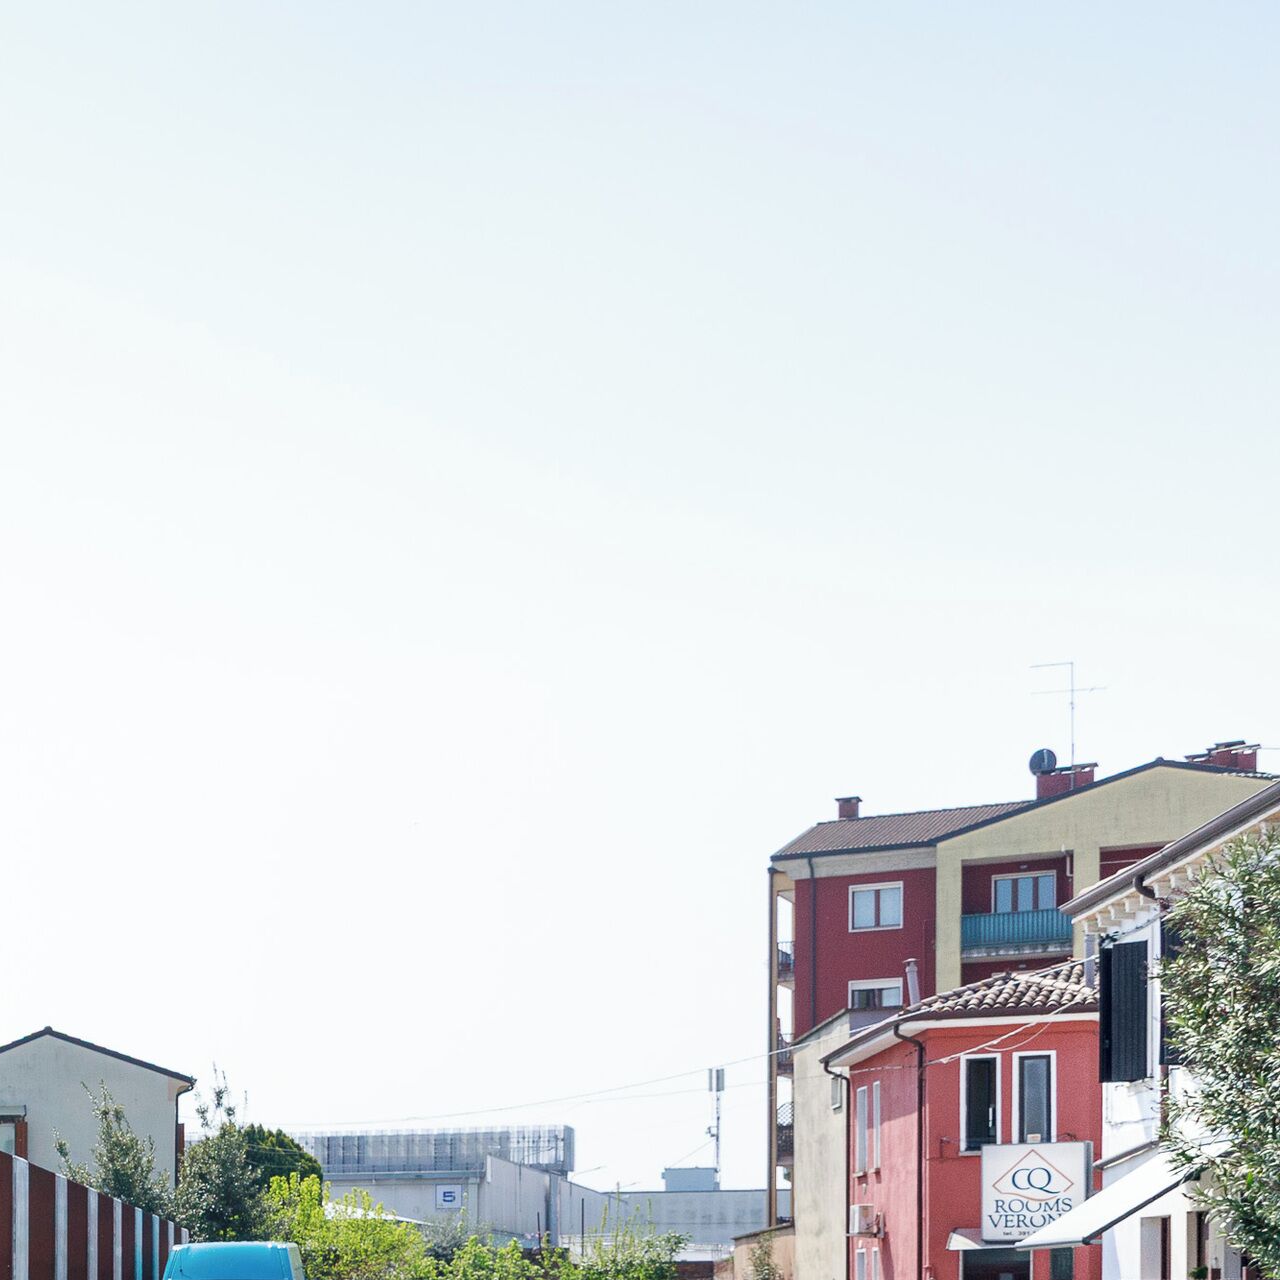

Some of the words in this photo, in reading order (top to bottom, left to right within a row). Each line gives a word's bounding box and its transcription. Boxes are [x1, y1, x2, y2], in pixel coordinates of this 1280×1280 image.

[1012, 1167, 1061, 1194] CQ
[443, 1191, 456, 1203] 5
[995, 1198, 1073, 1213] ROOMS
[988, 1213, 1062, 1228] VERON
